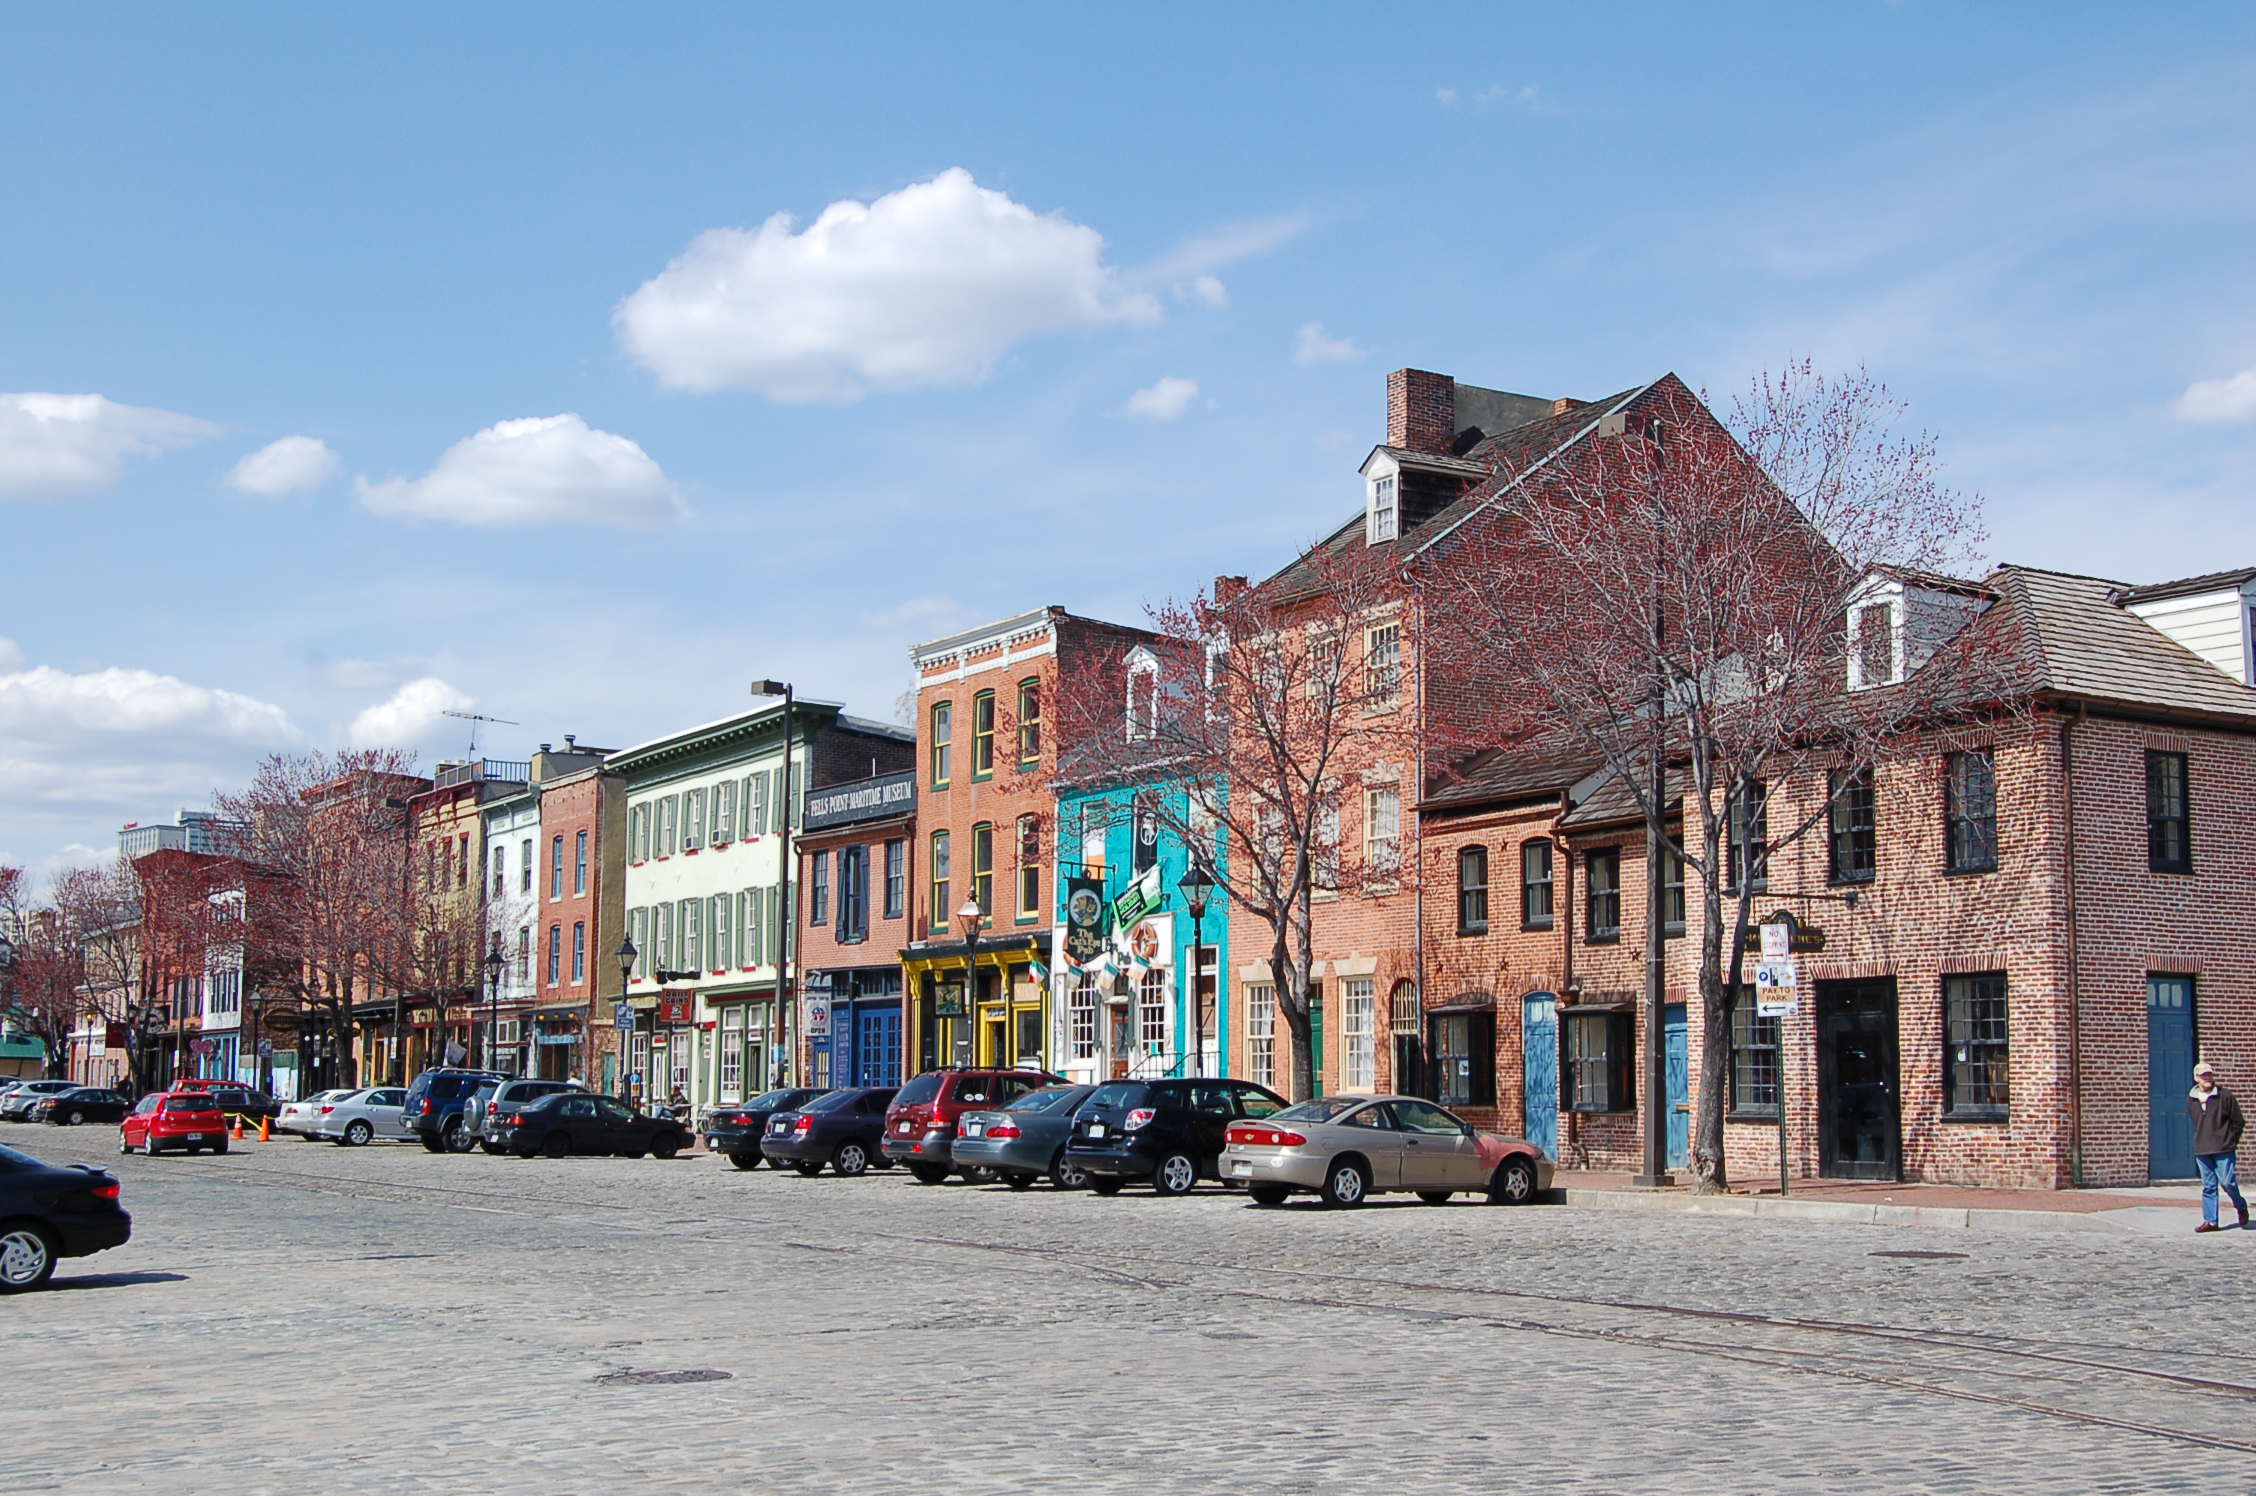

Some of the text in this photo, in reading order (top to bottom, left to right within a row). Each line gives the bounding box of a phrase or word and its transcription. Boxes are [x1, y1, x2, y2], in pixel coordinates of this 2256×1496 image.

[811, 781, 912, 816] FELLS POINT MARITIME MUSEUM
[1077, 928, 1094, 940] The
[1077, 946, 1094, 954] Pub
